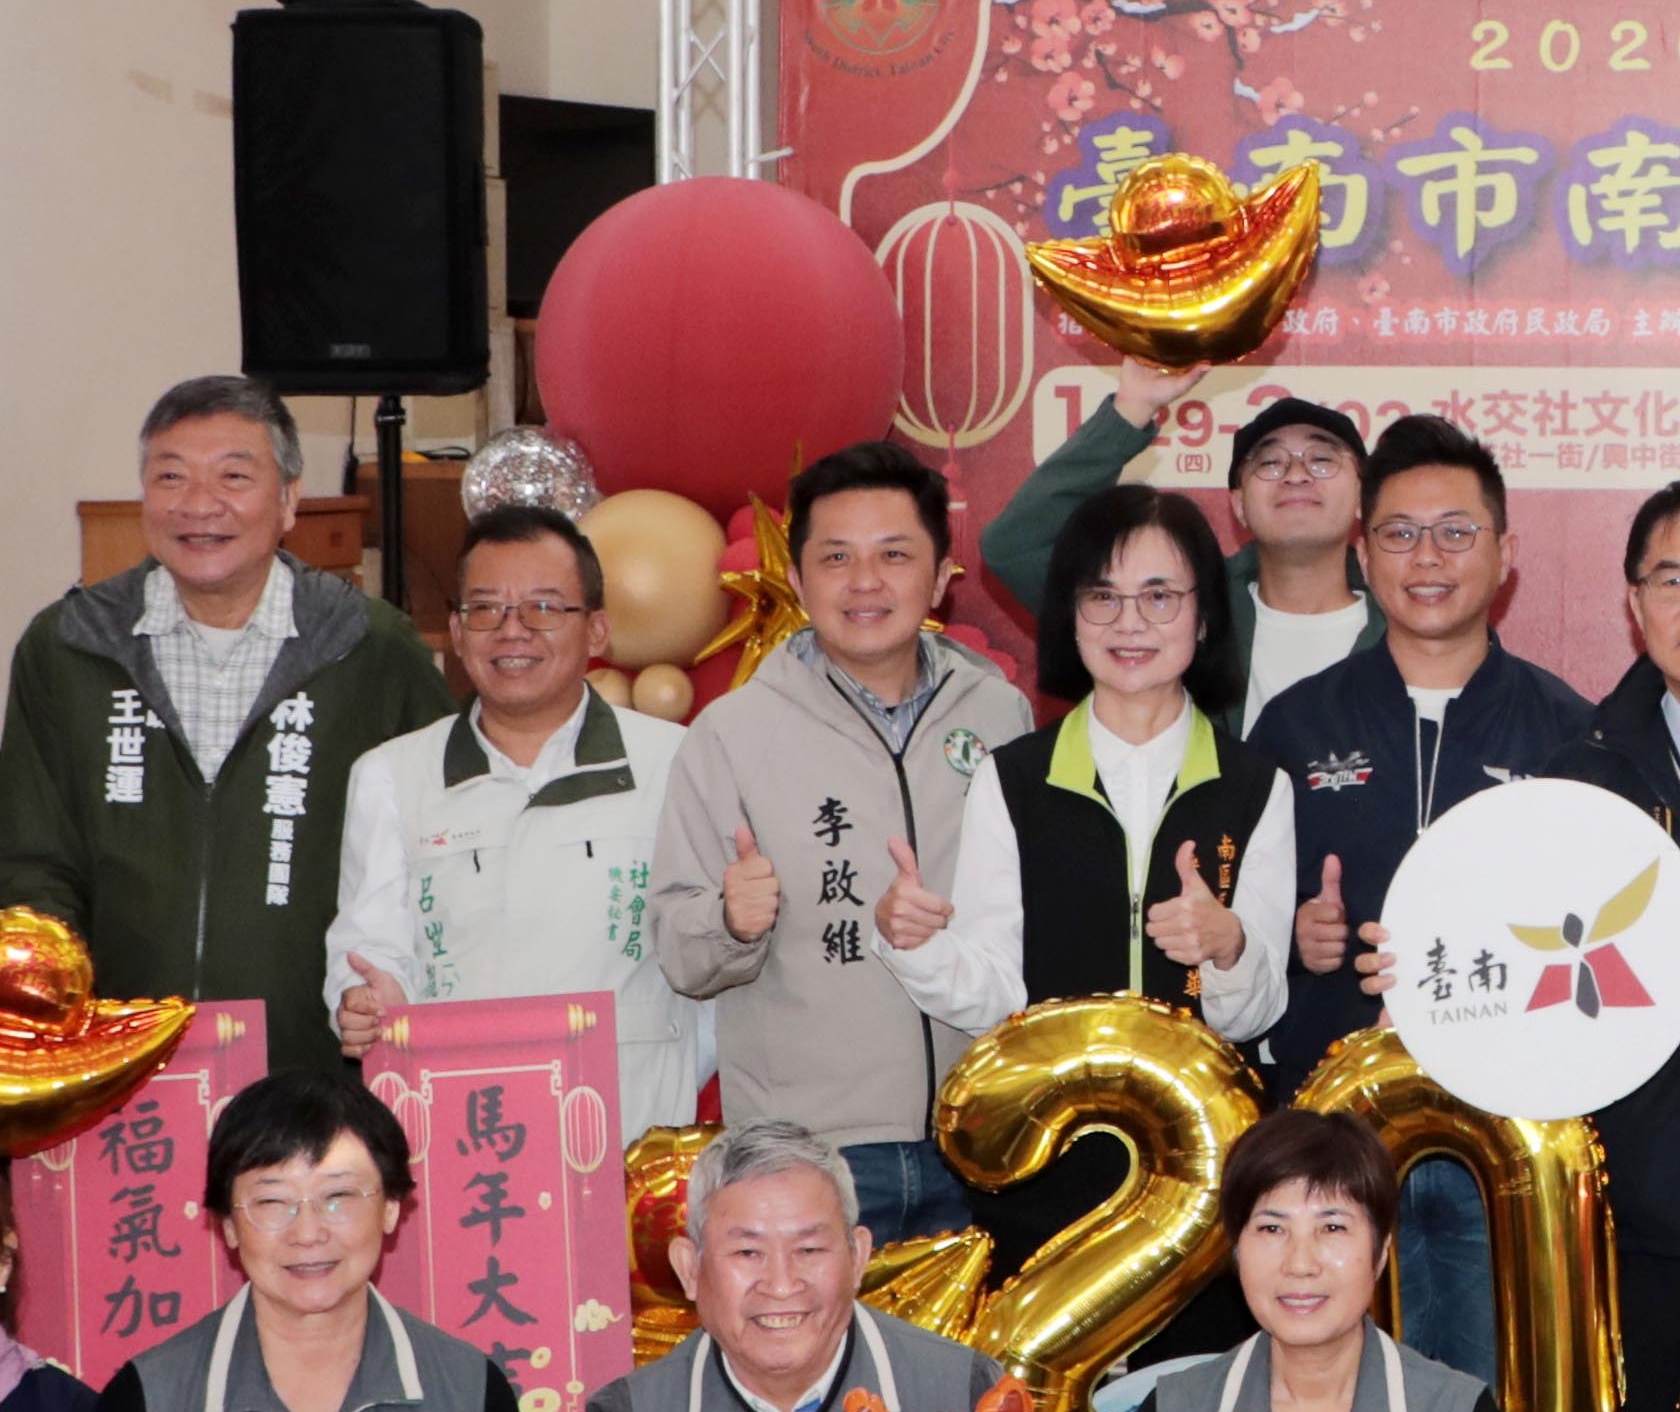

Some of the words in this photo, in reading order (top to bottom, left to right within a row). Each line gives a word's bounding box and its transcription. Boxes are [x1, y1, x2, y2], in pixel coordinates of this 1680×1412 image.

[1175, 452, 1213, 475] (四)
[104, 688, 146, 804] 王世運
[621, 860, 649, 962] 社會局
[1417, 937, 1508, 1003] 臺南
[1427, 1000, 1509, 1027] TAINAN
[98, 1098, 182, 1338] 福氣加
